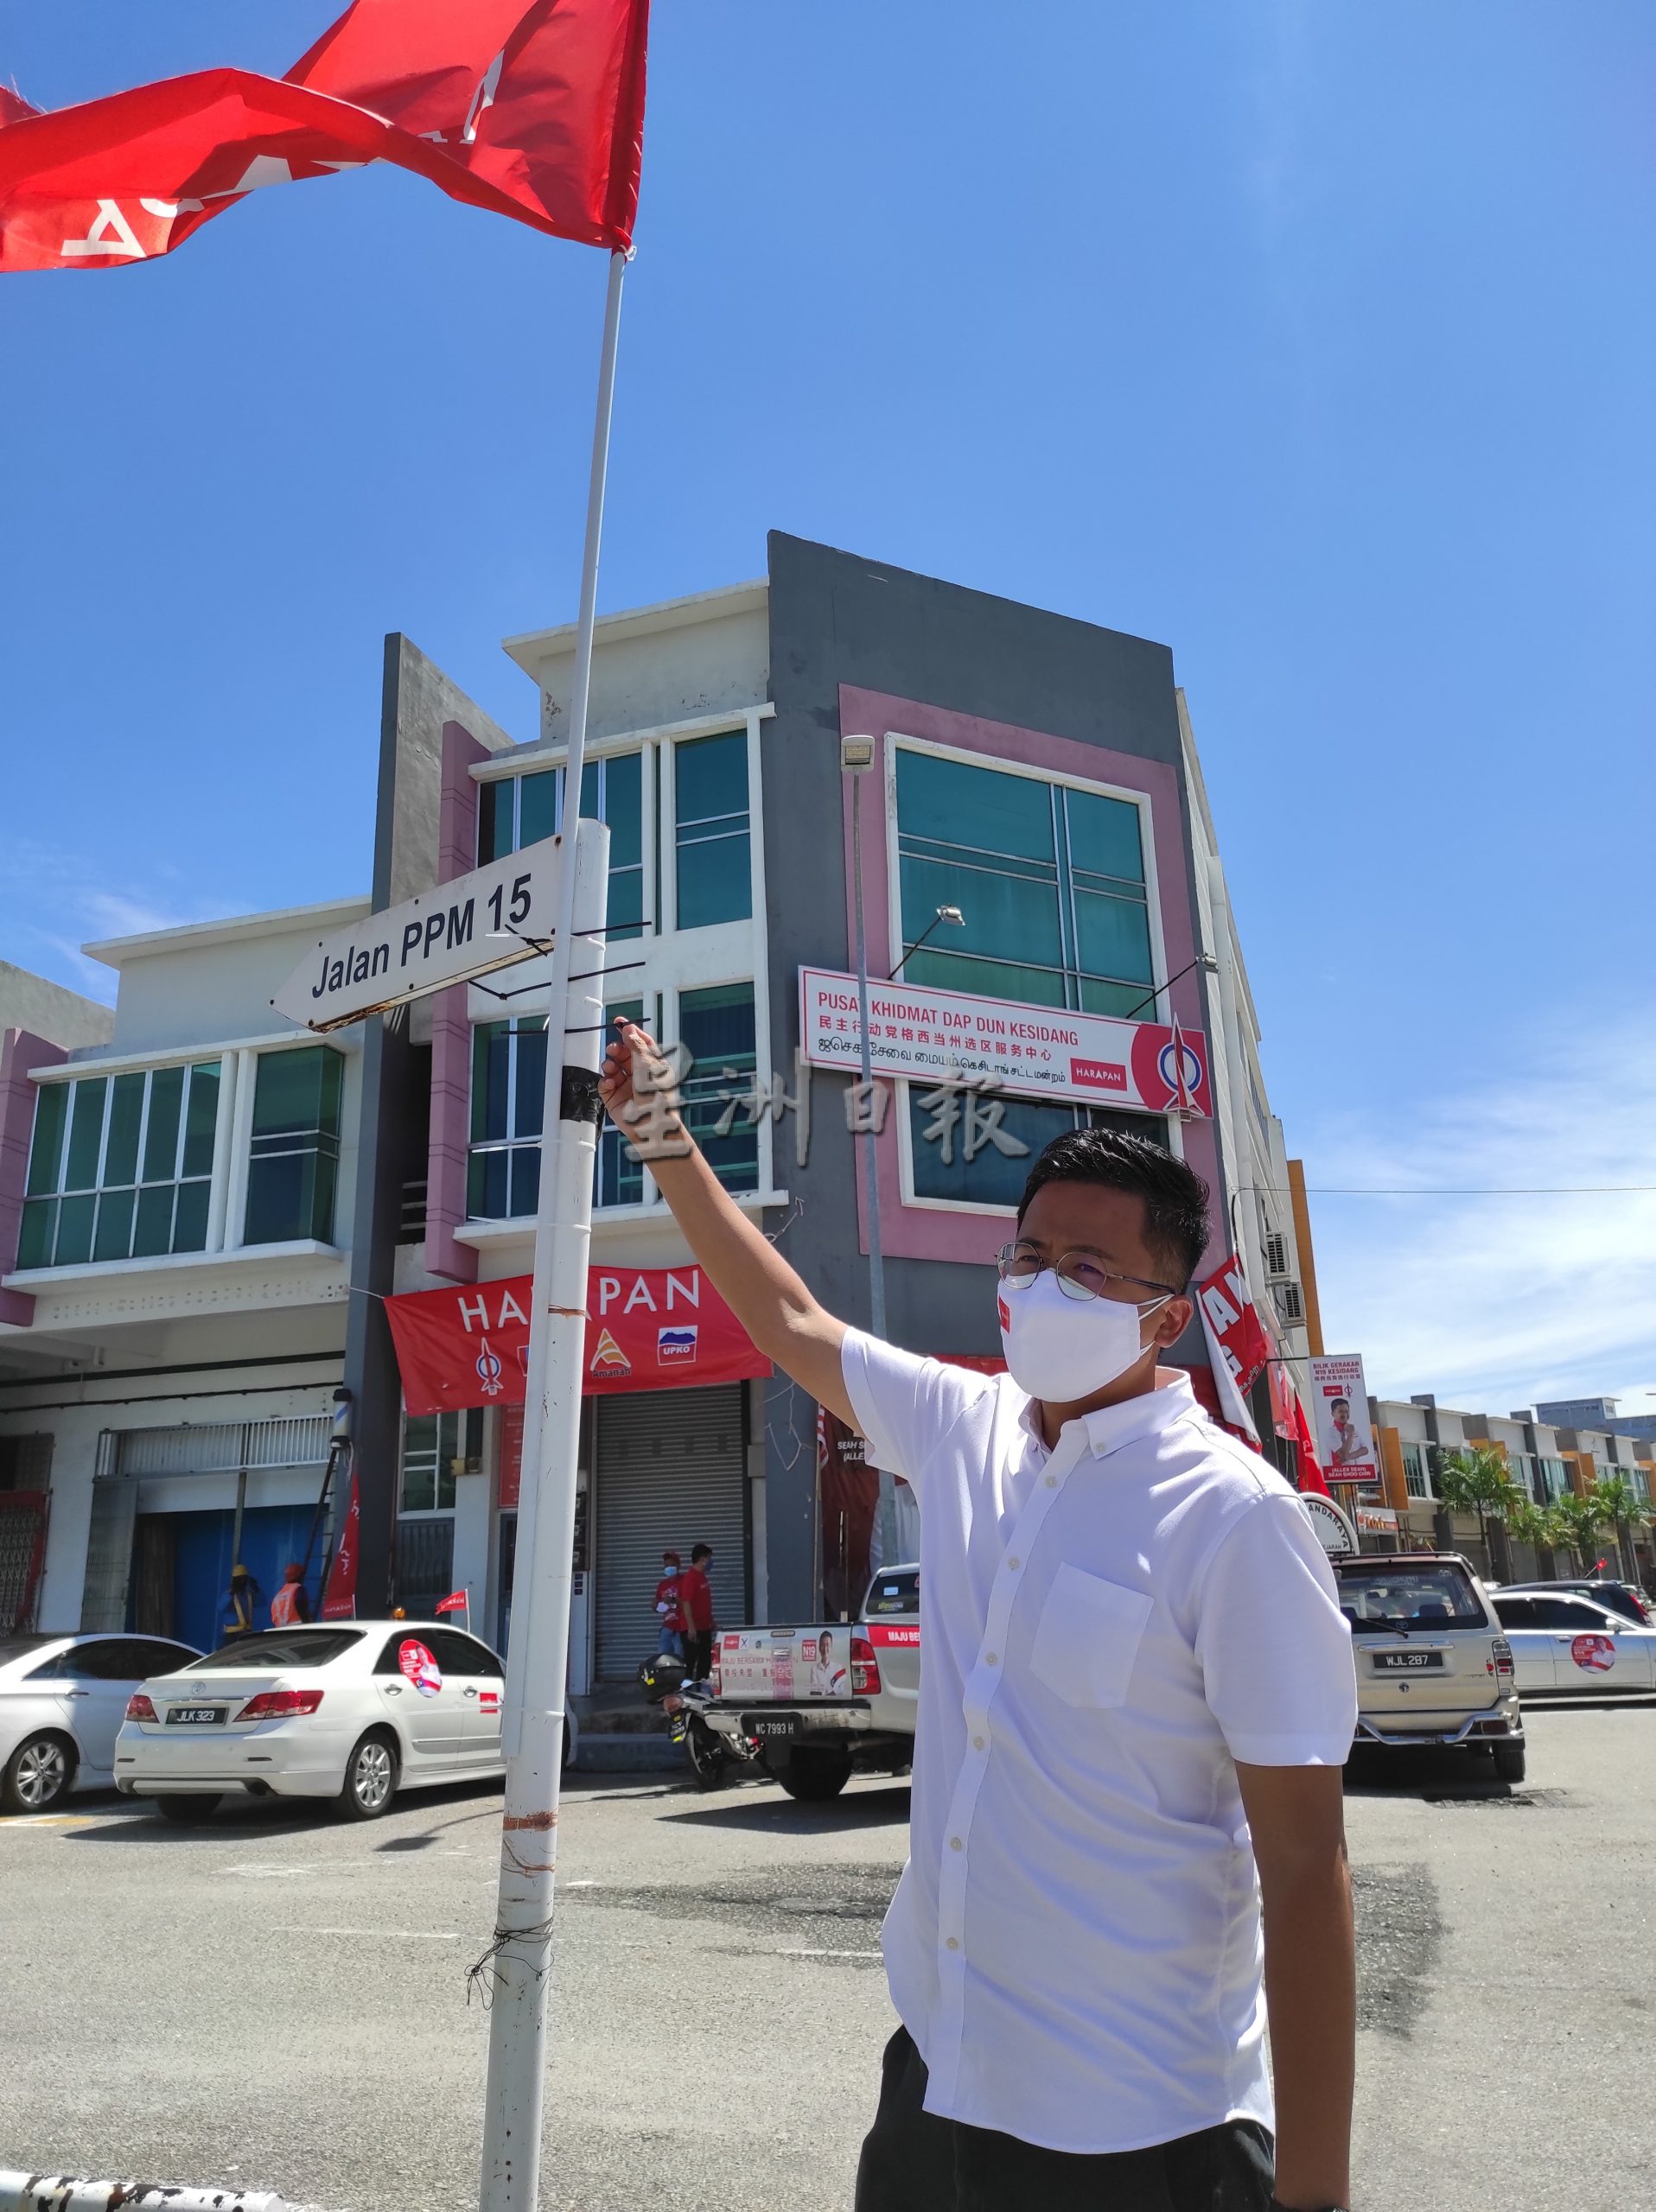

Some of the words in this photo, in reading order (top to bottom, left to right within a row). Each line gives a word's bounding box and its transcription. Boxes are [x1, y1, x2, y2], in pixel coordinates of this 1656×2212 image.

[312, 944, 389, 999] Jalan
[400, 897, 475, 967] PPM
[487, 873, 532, 931] 15
[818, 991, 859, 1012] PUSA
[871, 1000, 938, 1024] KHIDMAT
[943, 1012, 971, 1029] DAP
[977, 1017, 1005, 1035] DUN
[1010, 1021, 1079, 1046] KESIDANG
[1076, 1067, 1121, 1082] HARAPAN
[457, 1269, 699, 1332] HAPAN
[663, 1345, 691, 1356] UPKO
[593, 1366, 631, 1378] Amanah
[837, 1440, 857, 1450] SEAH
[843, 1452, 864, 1463] (ALLE
[1309, 1504, 1348, 1548] ANDARAYA
[888, 1631, 908, 1641] MAJU
[803, 1646, 816, 1656] N19
[1385, 1656, 1408, 1667] WJL
[1408, 1655, 1429, 1666] 287
[176, 1711, 195, 1722] JLK
[195, 1711, 215, 1722] 323
[755, 1723, 765, 1734] WC
[766, 1722, 786, 1734] 7993
[787, 1722, 794, 1734] H
